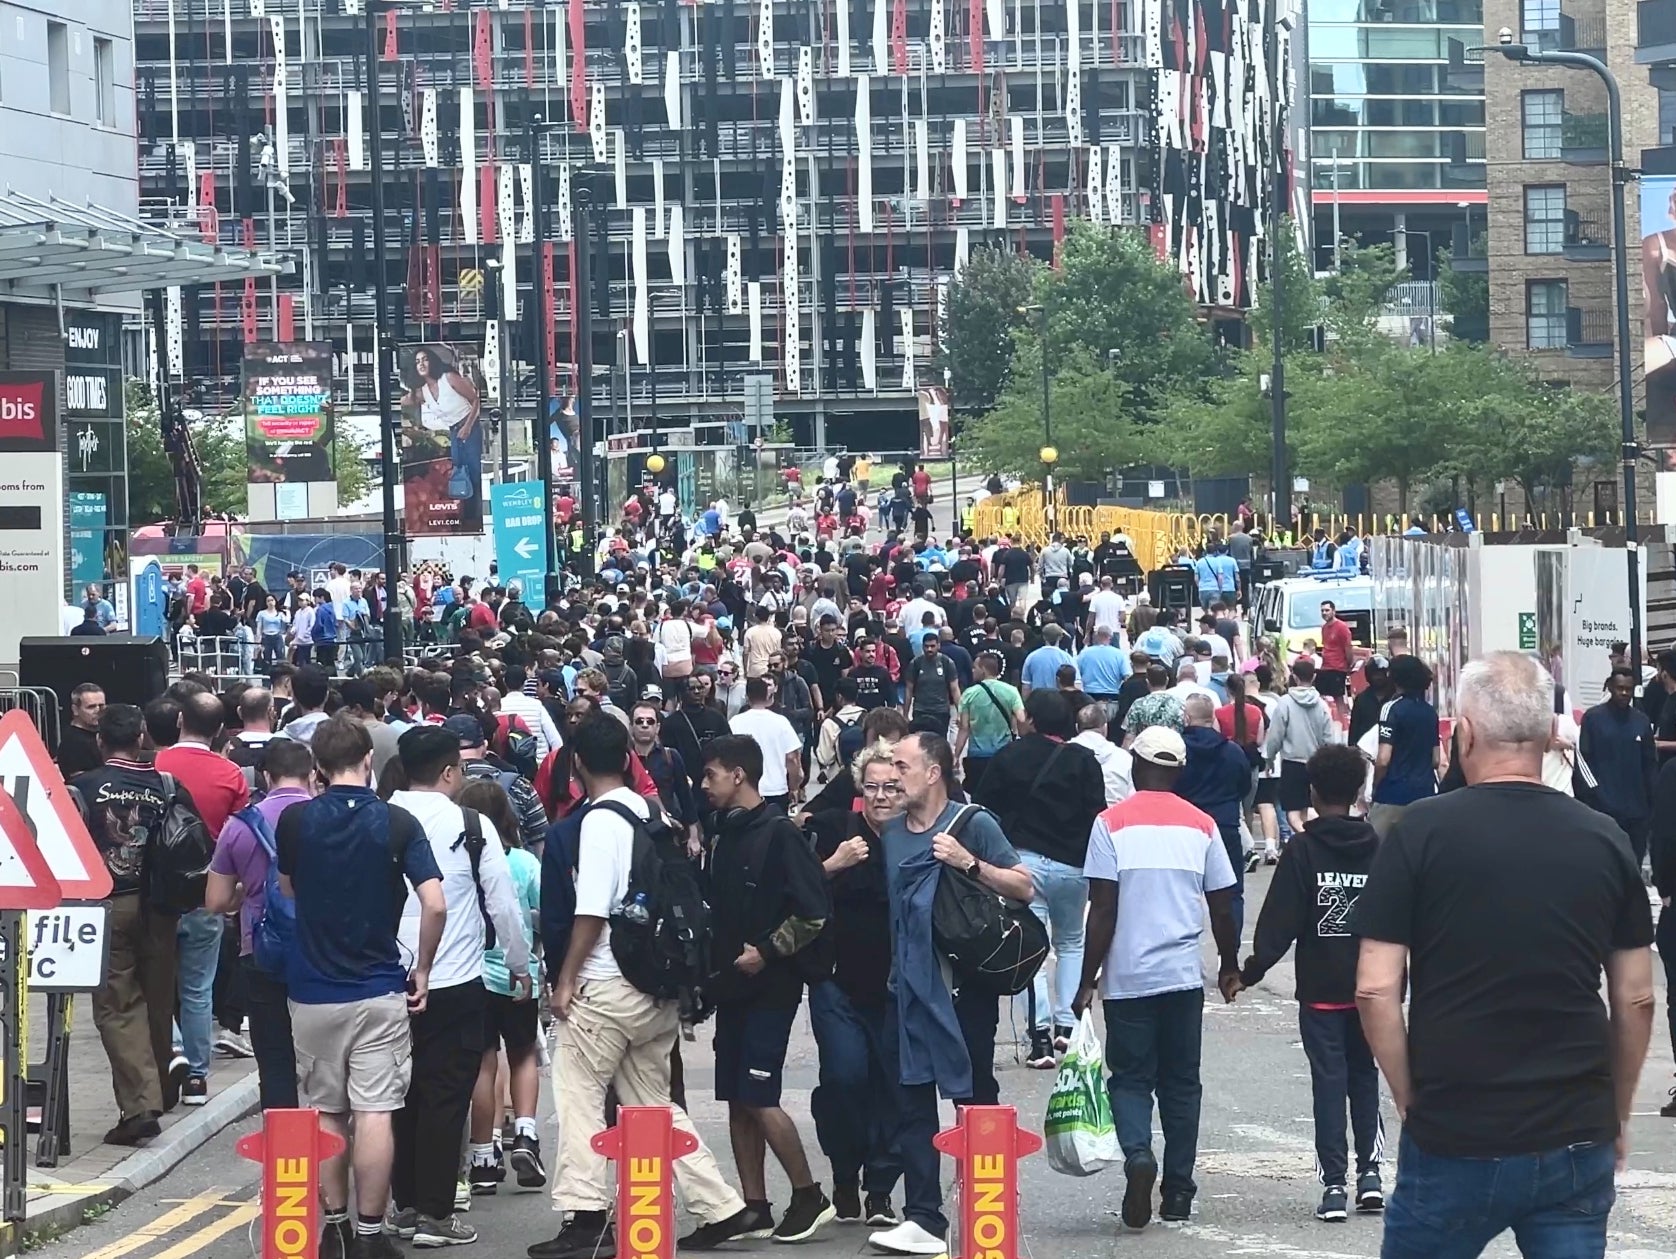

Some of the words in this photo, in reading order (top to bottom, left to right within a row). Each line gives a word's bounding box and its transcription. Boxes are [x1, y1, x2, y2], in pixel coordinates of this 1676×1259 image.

[69, 327, 99, 349] ENJOY
[271, 355, 288, 363] ACT
[258, 377, 269, 386] IF
[271, 377, 294, 386] YOU
[297, 376, 317, 385] SEE
[67, 376, 85, 409] GOOD
[85, 376, 106, 409] TIMES
[256, 386, 320, 395] SOMETHING
[250, 396, 279, 405] THAT
[280, 395, 327, 405] DOESN'T
[1, 397, 35, 420] bis
[258, 405, 285, 414] FEEL
[287, 404, 320, 414] RIGHT
[22, 479, 45, 491] from
[502, 499, 533, 507] WEMBLEY
[521, 515, 543, 527] DROP
[0, 560, 39, 571] bis.com
[1582, 620, 1593, 632] Big
[1594, 621, 1618, 631] brands.
[1577, 636, 1594, 648] Huge
[35, 915, 97, 944] file
[275, 1157, 308, 1259] ONE
[629, 1157, 661, 1259] ONE
